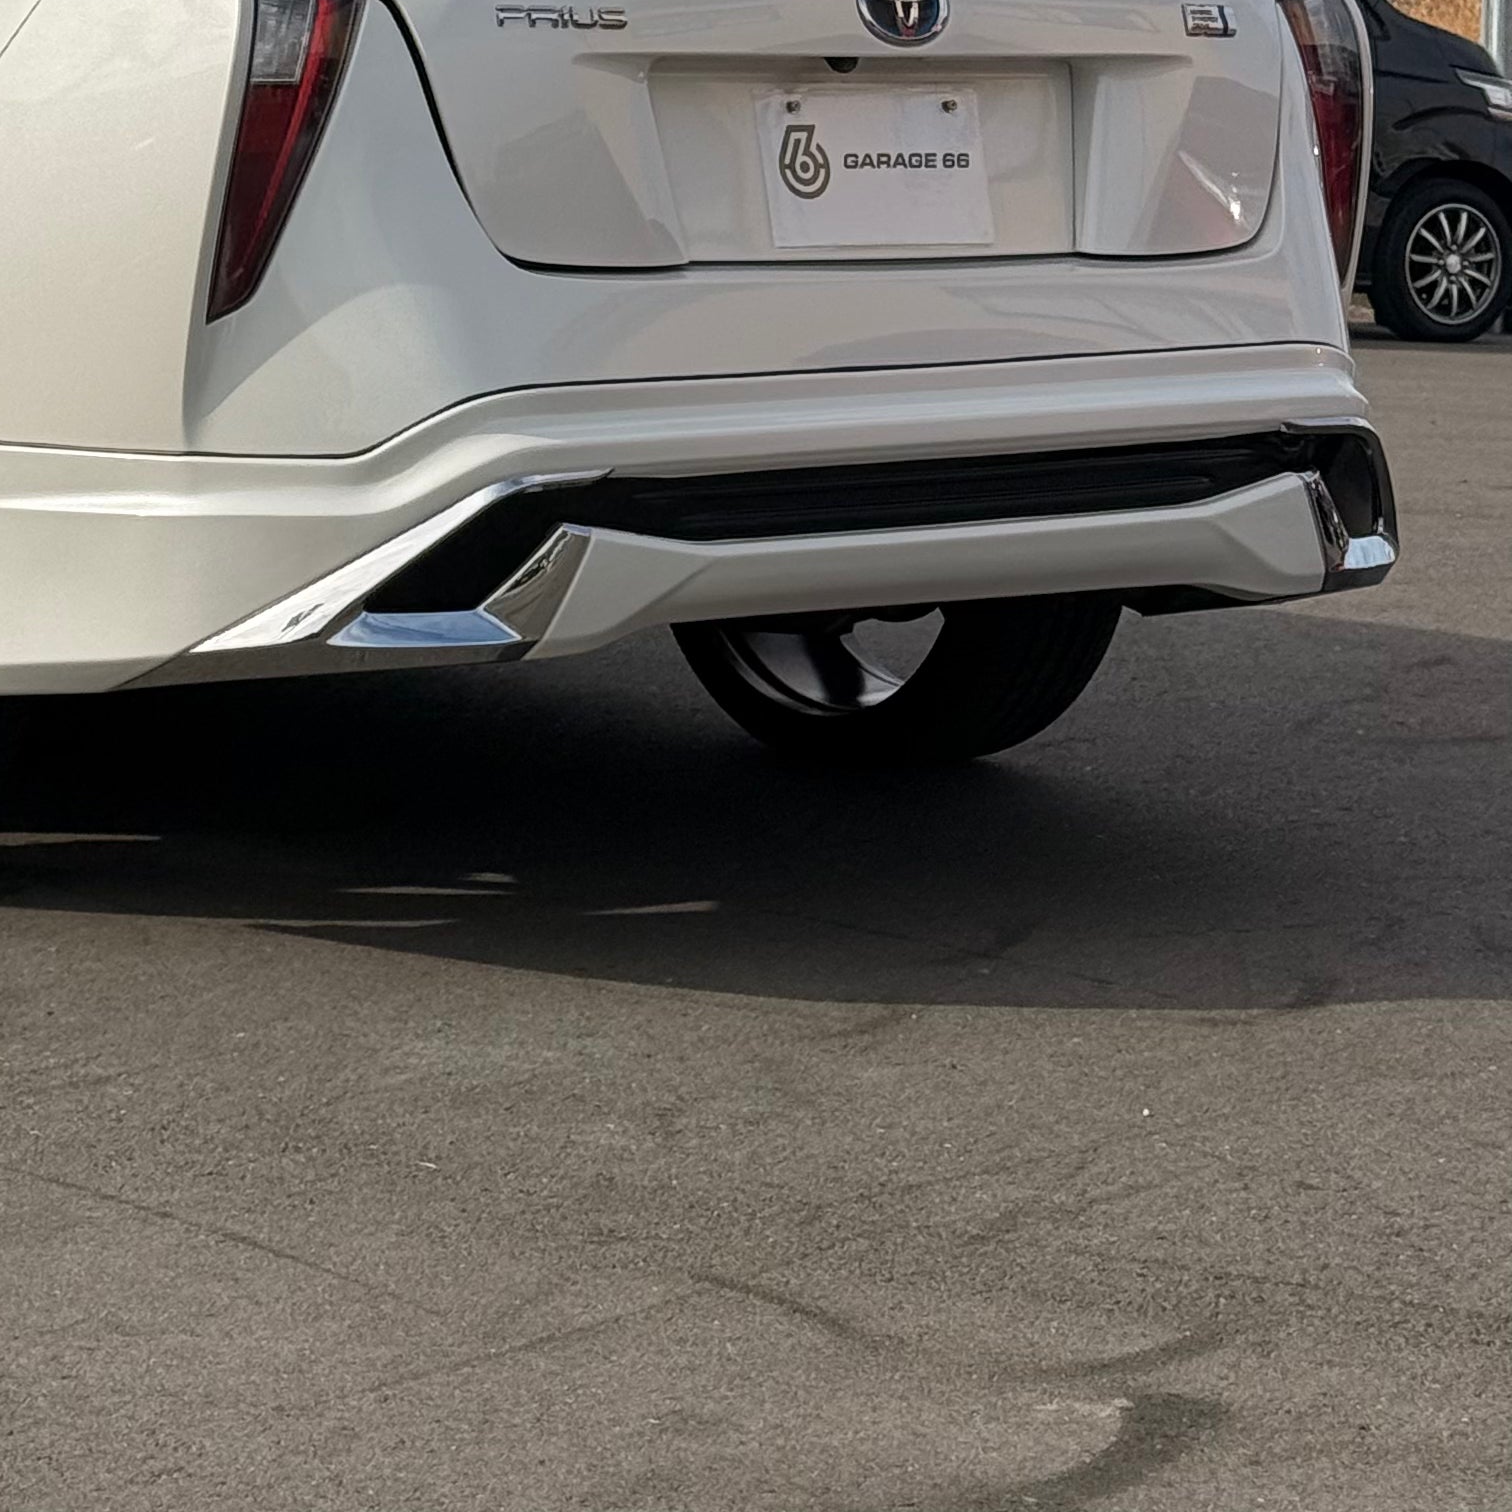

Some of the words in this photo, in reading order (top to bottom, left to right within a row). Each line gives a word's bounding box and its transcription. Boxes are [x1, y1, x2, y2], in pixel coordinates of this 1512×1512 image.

[495, 4, 628, 30] PRIUS
[843, 152, 938, 170] GARAGE
[942, 152, 970, 169] 66
